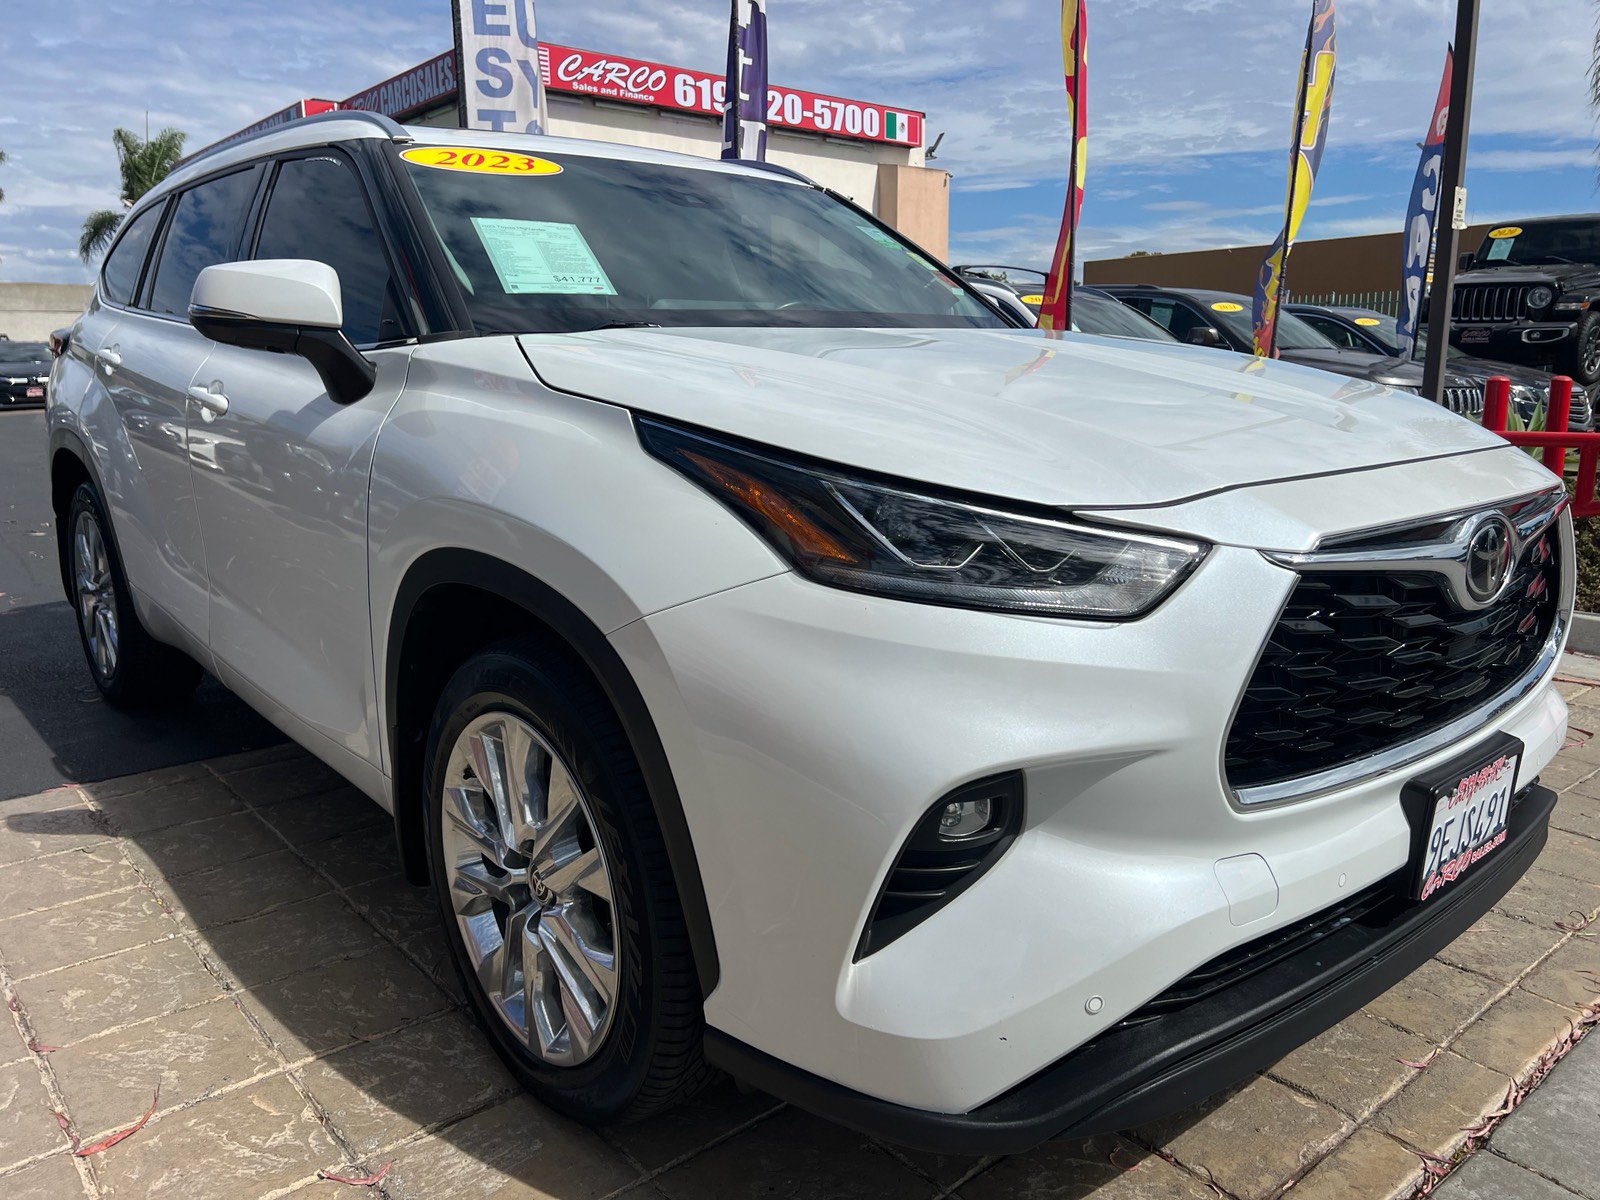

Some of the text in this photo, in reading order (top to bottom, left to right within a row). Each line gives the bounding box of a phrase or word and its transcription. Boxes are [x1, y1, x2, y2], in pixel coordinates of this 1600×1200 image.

[557, 53, 667, 92] CARCO
[572, 81, 655, 102] Sales and Finance
[434, 150, 535, 171] 2023
[552, 275, 601, 284] $41,777
[1425, 786, 1507, 878] 9EJS491
